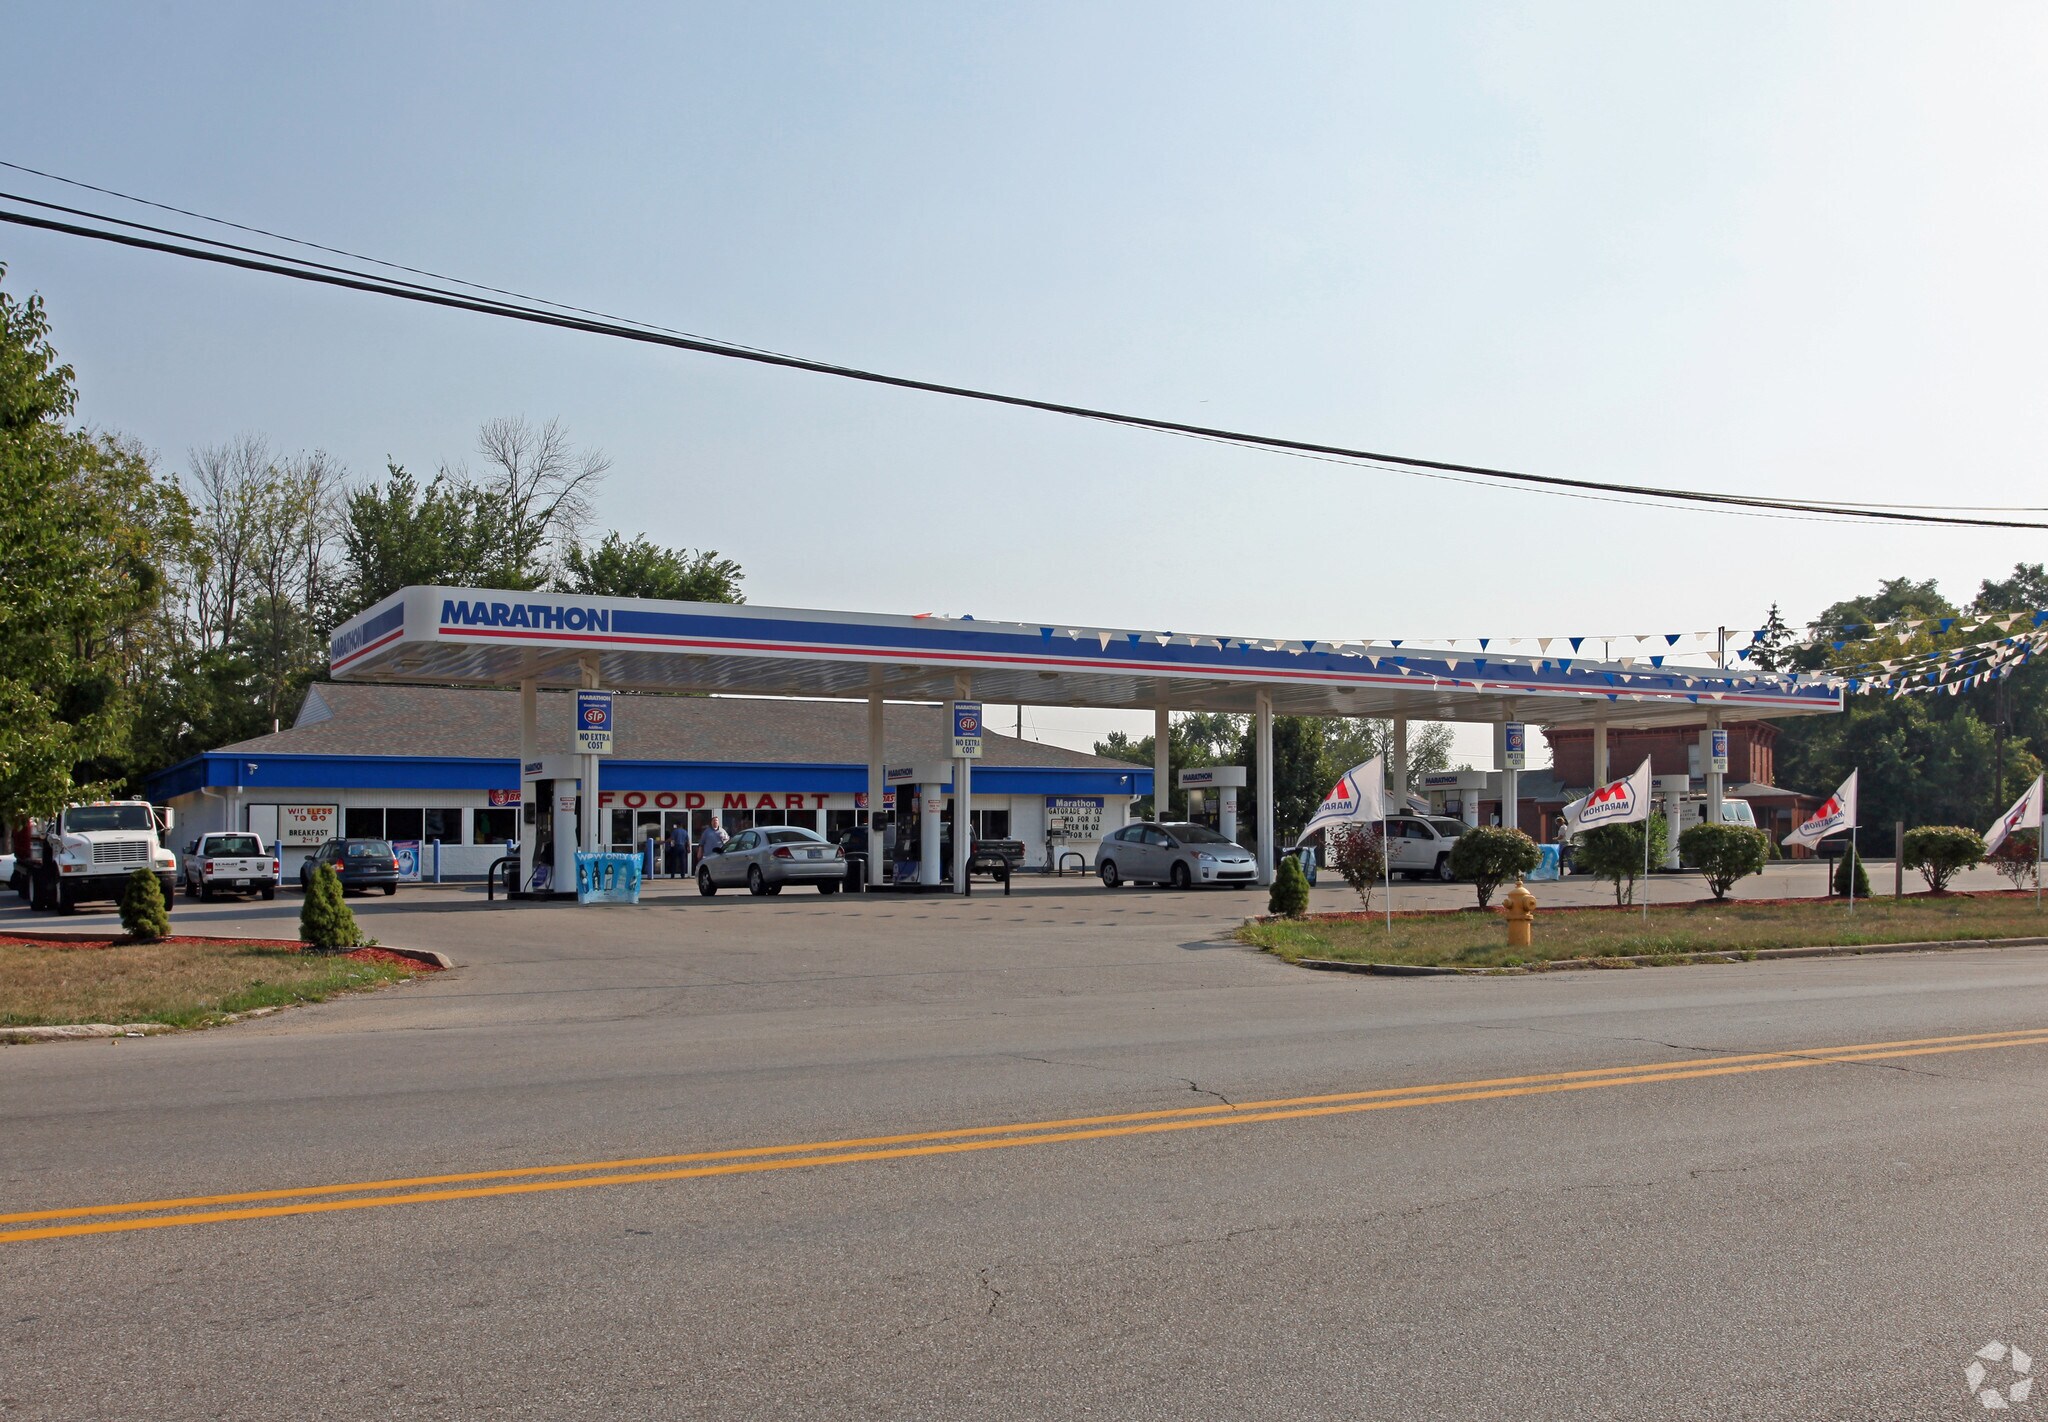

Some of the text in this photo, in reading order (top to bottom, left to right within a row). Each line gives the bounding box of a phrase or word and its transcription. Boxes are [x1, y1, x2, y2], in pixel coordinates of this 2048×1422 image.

[440, 600, 609, 632] MARATHON
[331, 625, 363, 661] MARATHON
[588, 711, 603, 721] STP
[962, 719, 975, 728] STP
[579, 733, 610, 741] NO EXTRA
[588, 741, 603, 749] COST
[888, 768, 913, 777] MARATHON
[1183, 772, 1212, 780] MARATHON
[1425, 776, 1457, 784] MARATHON
[598, 792, 830, 809] FOOD MART
[1056, 799, 1096, 807] Marathon
